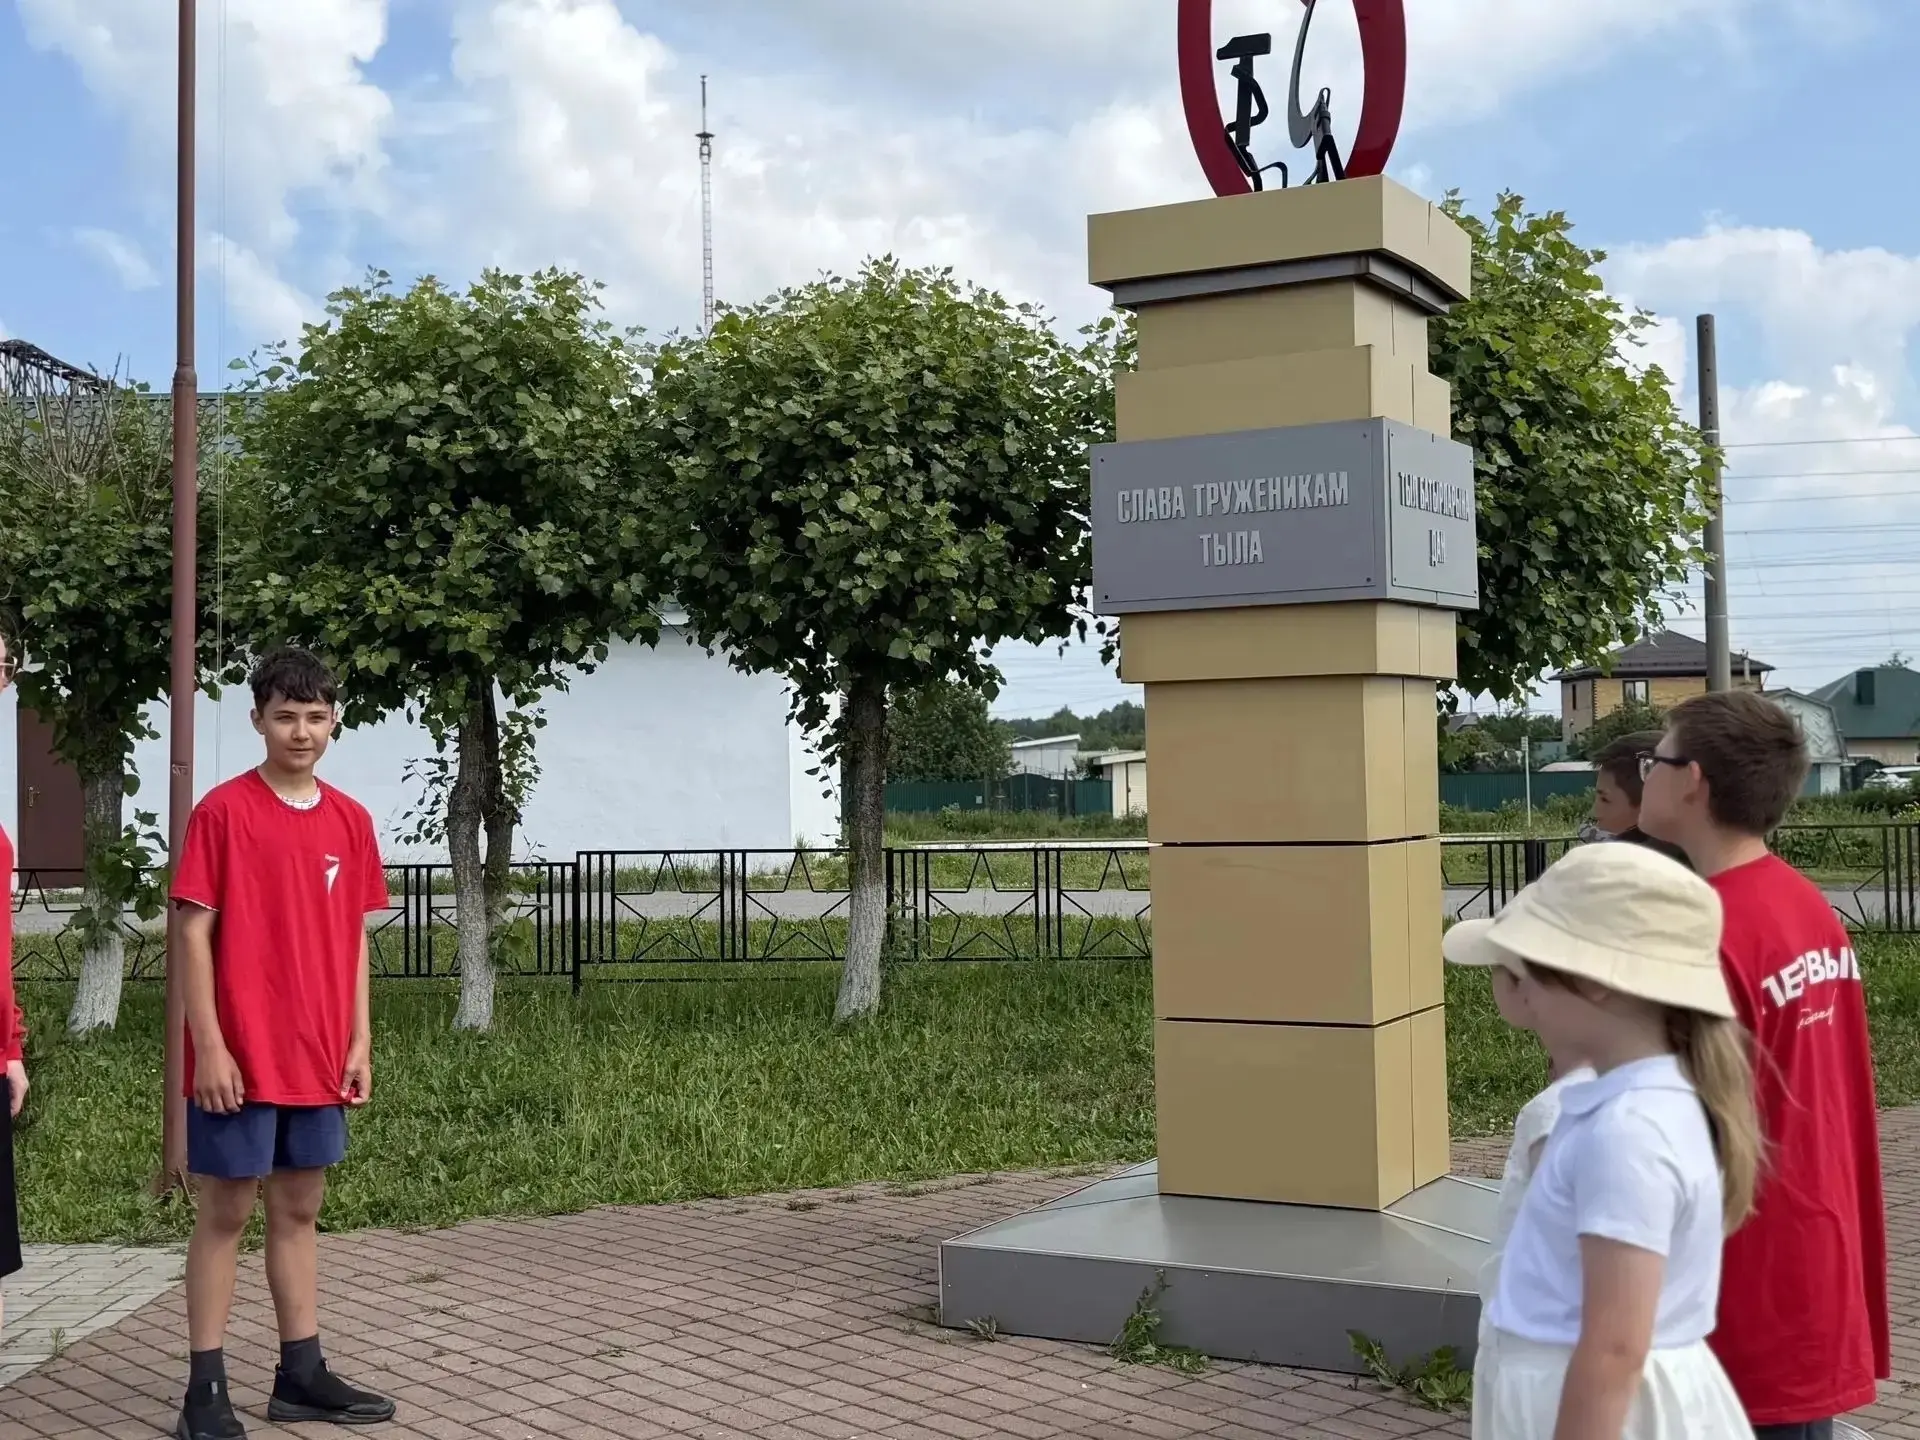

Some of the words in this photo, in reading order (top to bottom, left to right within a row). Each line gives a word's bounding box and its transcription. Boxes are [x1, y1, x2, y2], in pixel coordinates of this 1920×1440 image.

[1117, 486, 1186, 523] СЛАВА
[1193, 471, 1349, 517] ТРУЖЕНИКАМ
[1200, 530, 1264, 567] ТЫЛА
